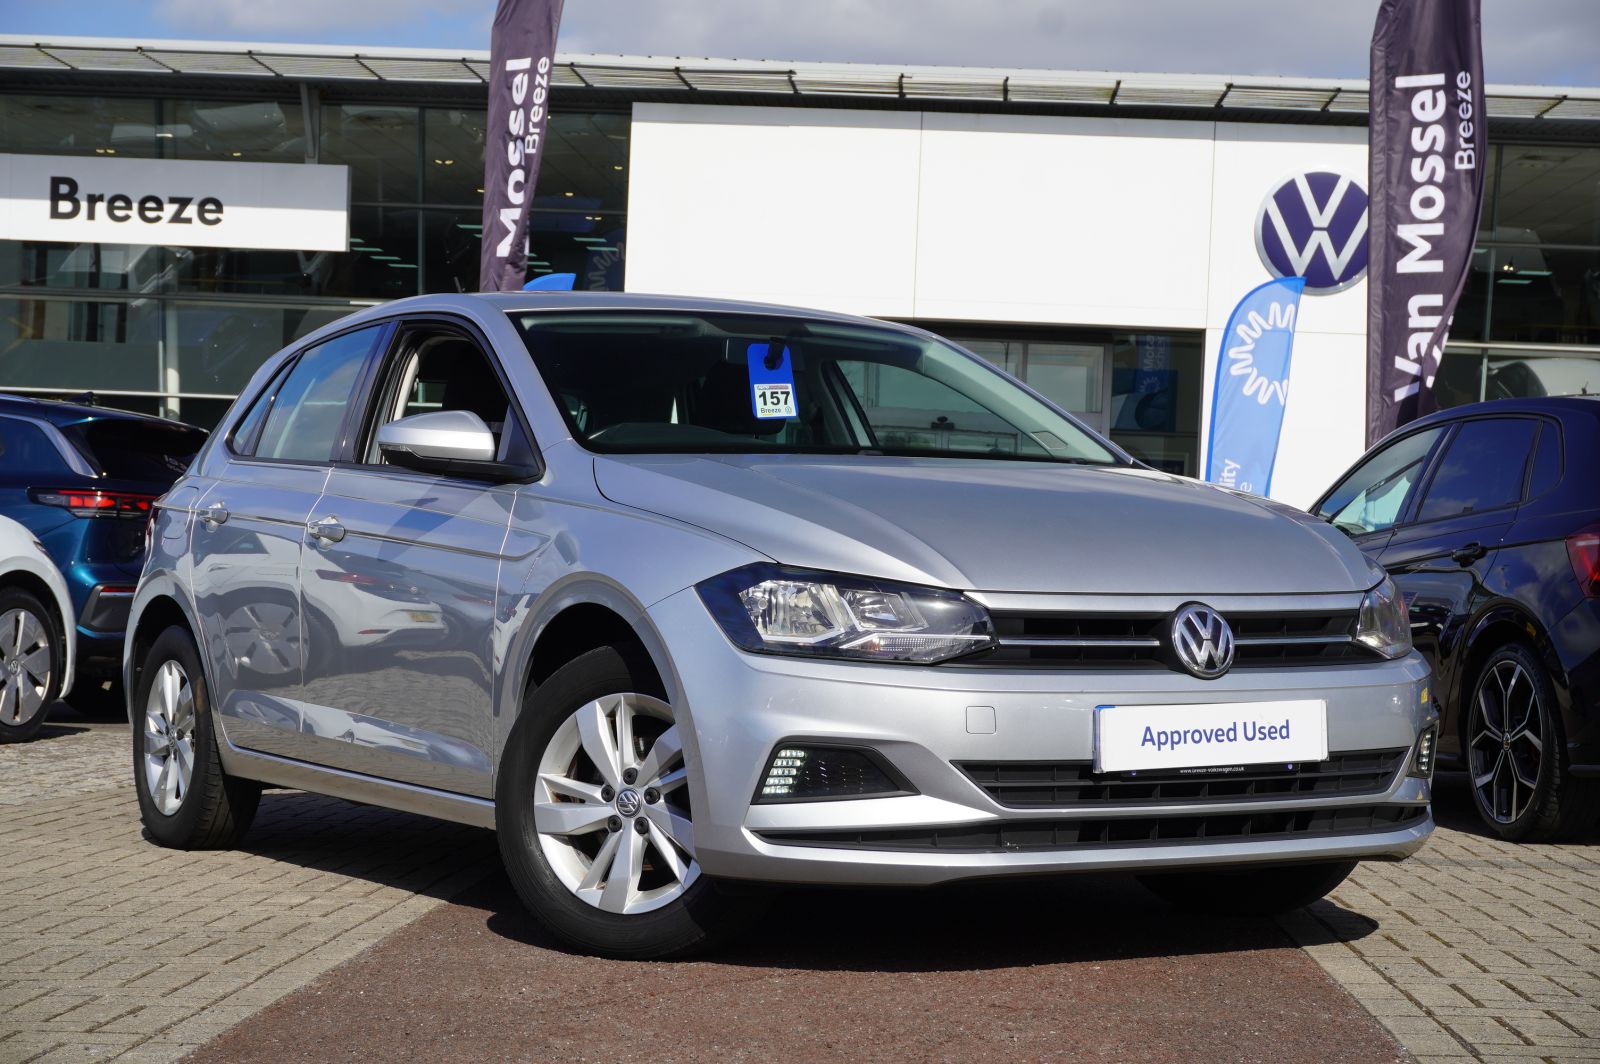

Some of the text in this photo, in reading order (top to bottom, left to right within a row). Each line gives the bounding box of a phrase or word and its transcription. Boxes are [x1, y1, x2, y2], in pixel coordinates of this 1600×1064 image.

[525, 56, 550, 155] Breeze
[1454, 70, 1476, 170] Breeze
[49, 175, 224, 226] Breeze
[496, 57, 532, 258] Mossel
[1394, 72, 1447, 274] Mossel
[758, 390, 791, 406] 157
[1141, 719, 1290, 751] Approved Used
